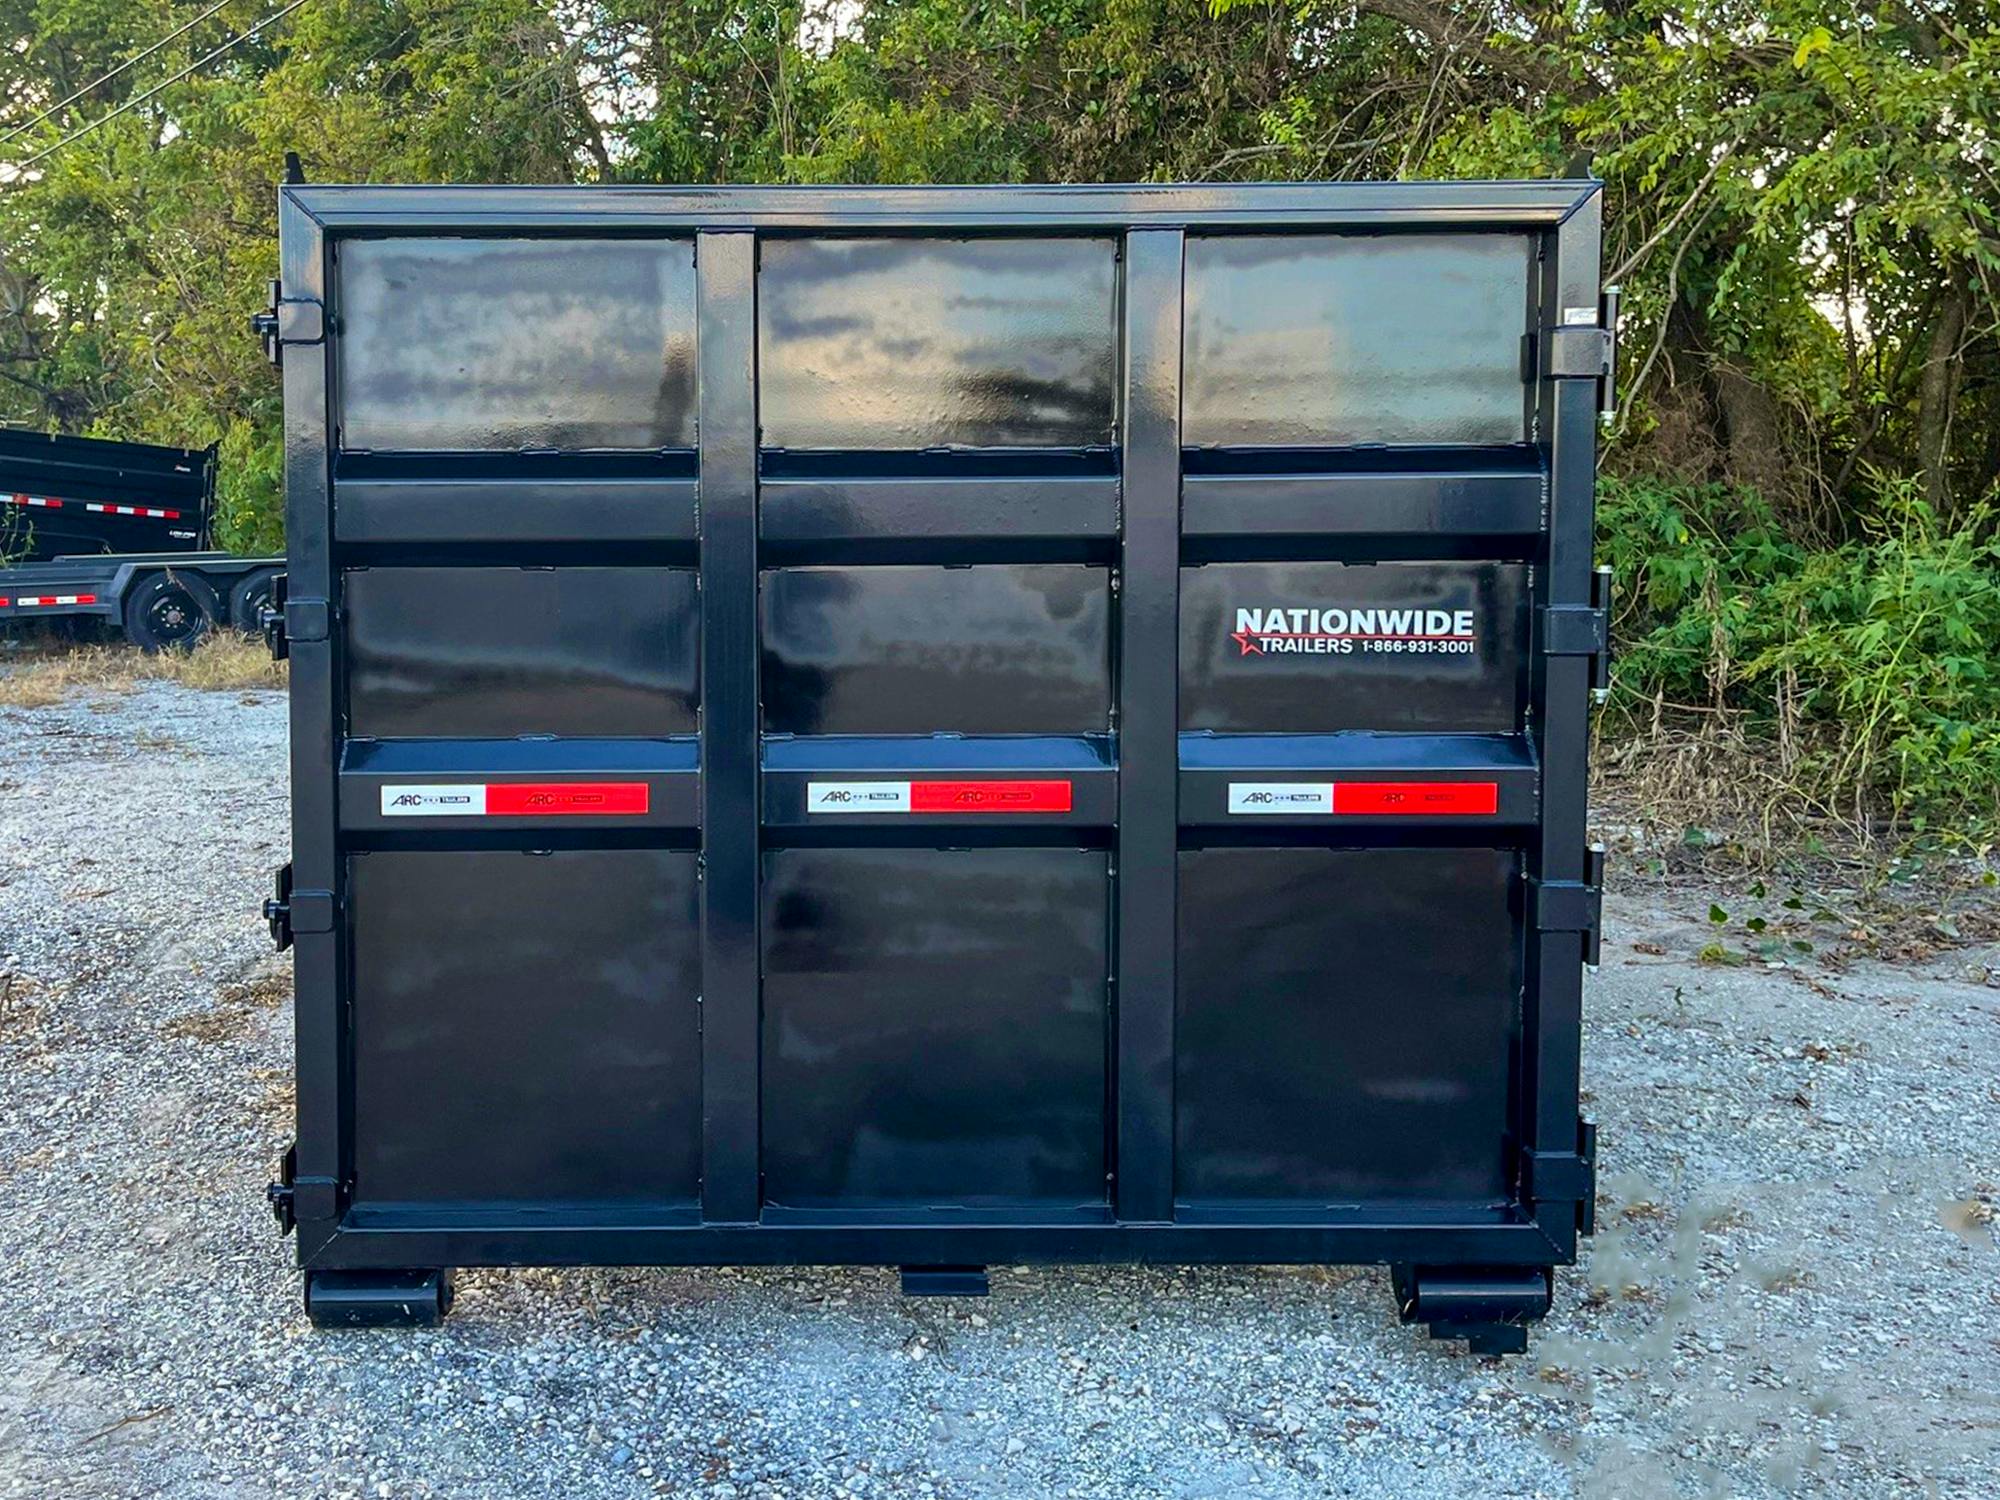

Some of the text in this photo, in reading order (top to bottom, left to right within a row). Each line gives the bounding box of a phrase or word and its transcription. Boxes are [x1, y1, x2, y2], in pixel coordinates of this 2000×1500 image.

[1236, 608, 1474, 636] NATIONWIDE
[1259, 637, 1474, 654] TRAILERS 1-866-931-3001
[391, 794, 422, 806] ARC
[821, 791, 851, 802] ARC
[1242, 792, 1273, 804] ARC
